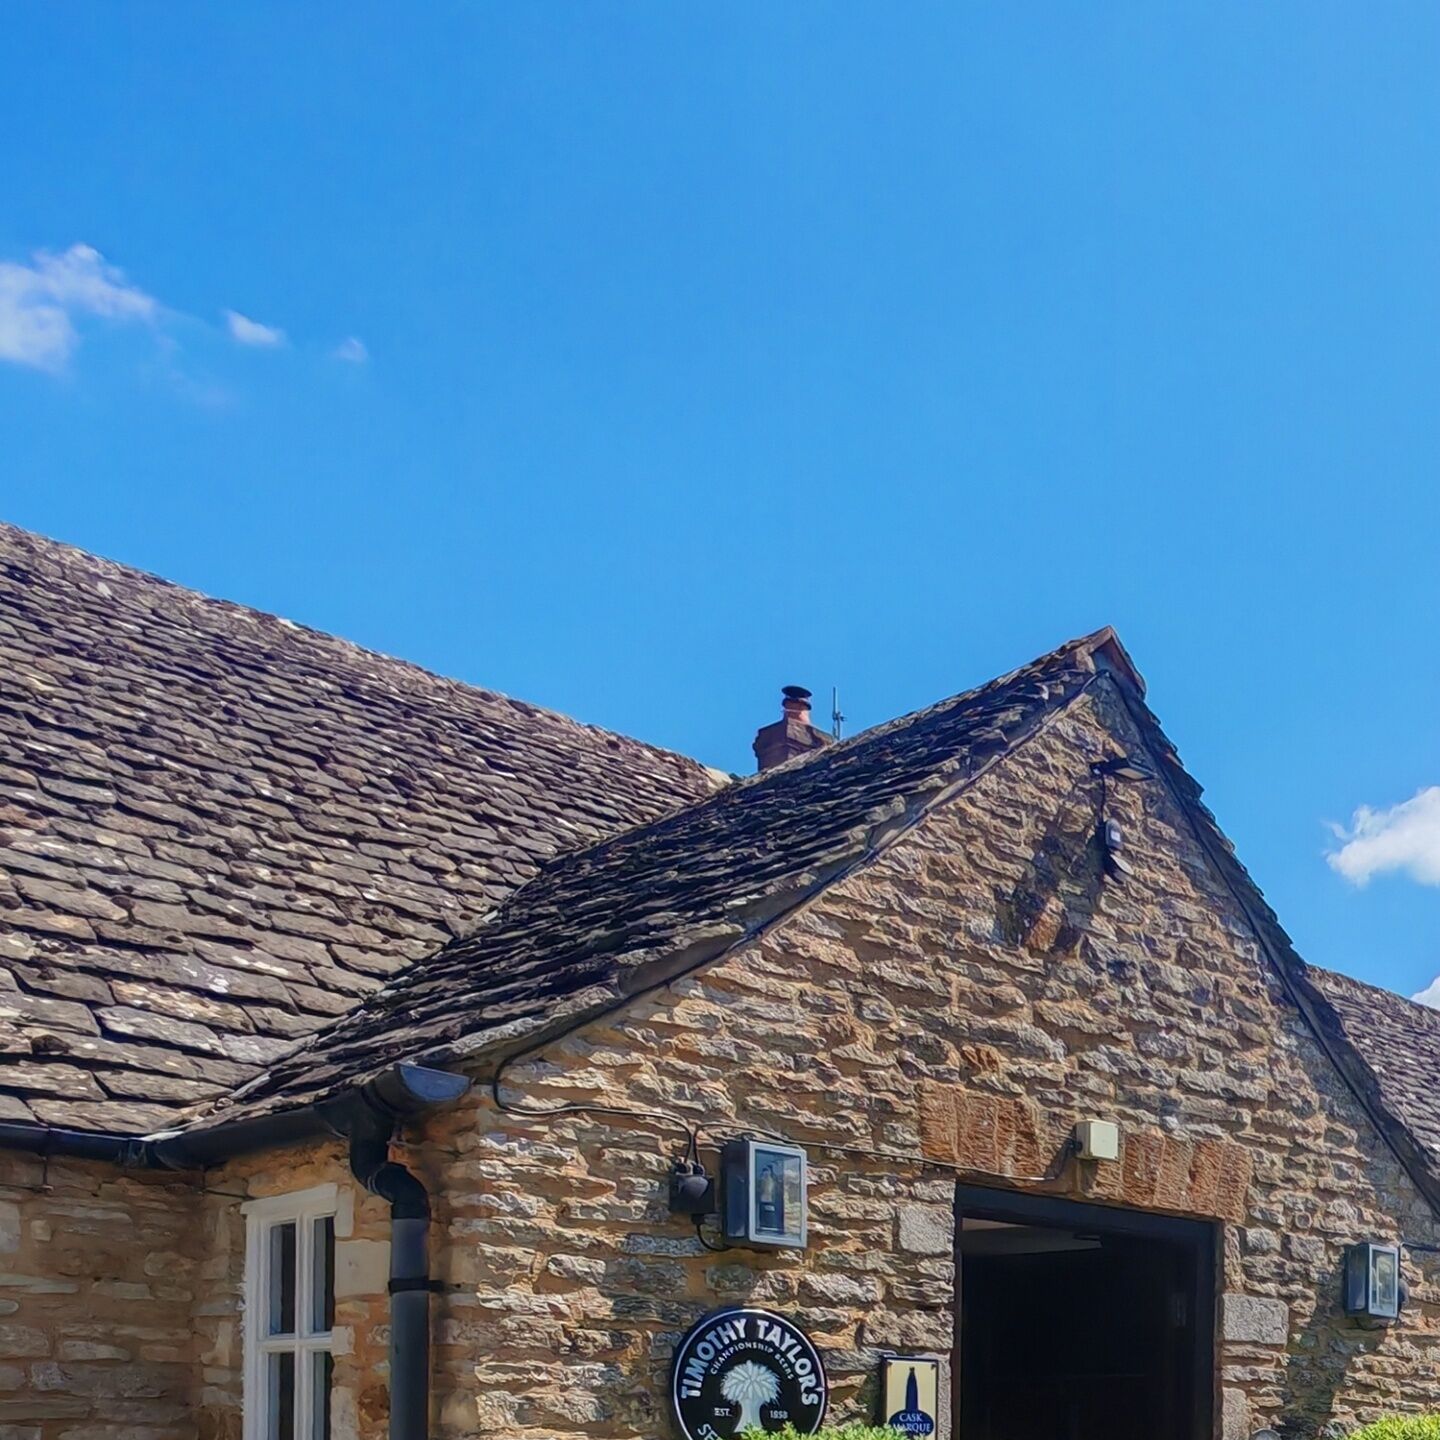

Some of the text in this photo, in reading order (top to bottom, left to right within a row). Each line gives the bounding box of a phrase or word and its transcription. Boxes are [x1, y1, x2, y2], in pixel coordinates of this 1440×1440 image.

[681, 1318, 823, 1405] TIMOTHY TAYLOR'S
[710, 1341, 773, 1374] CHAMPIONSHIP
[714, 1407, 732, 1417] EST.
[899, 1412, 923, 1422] CASK
